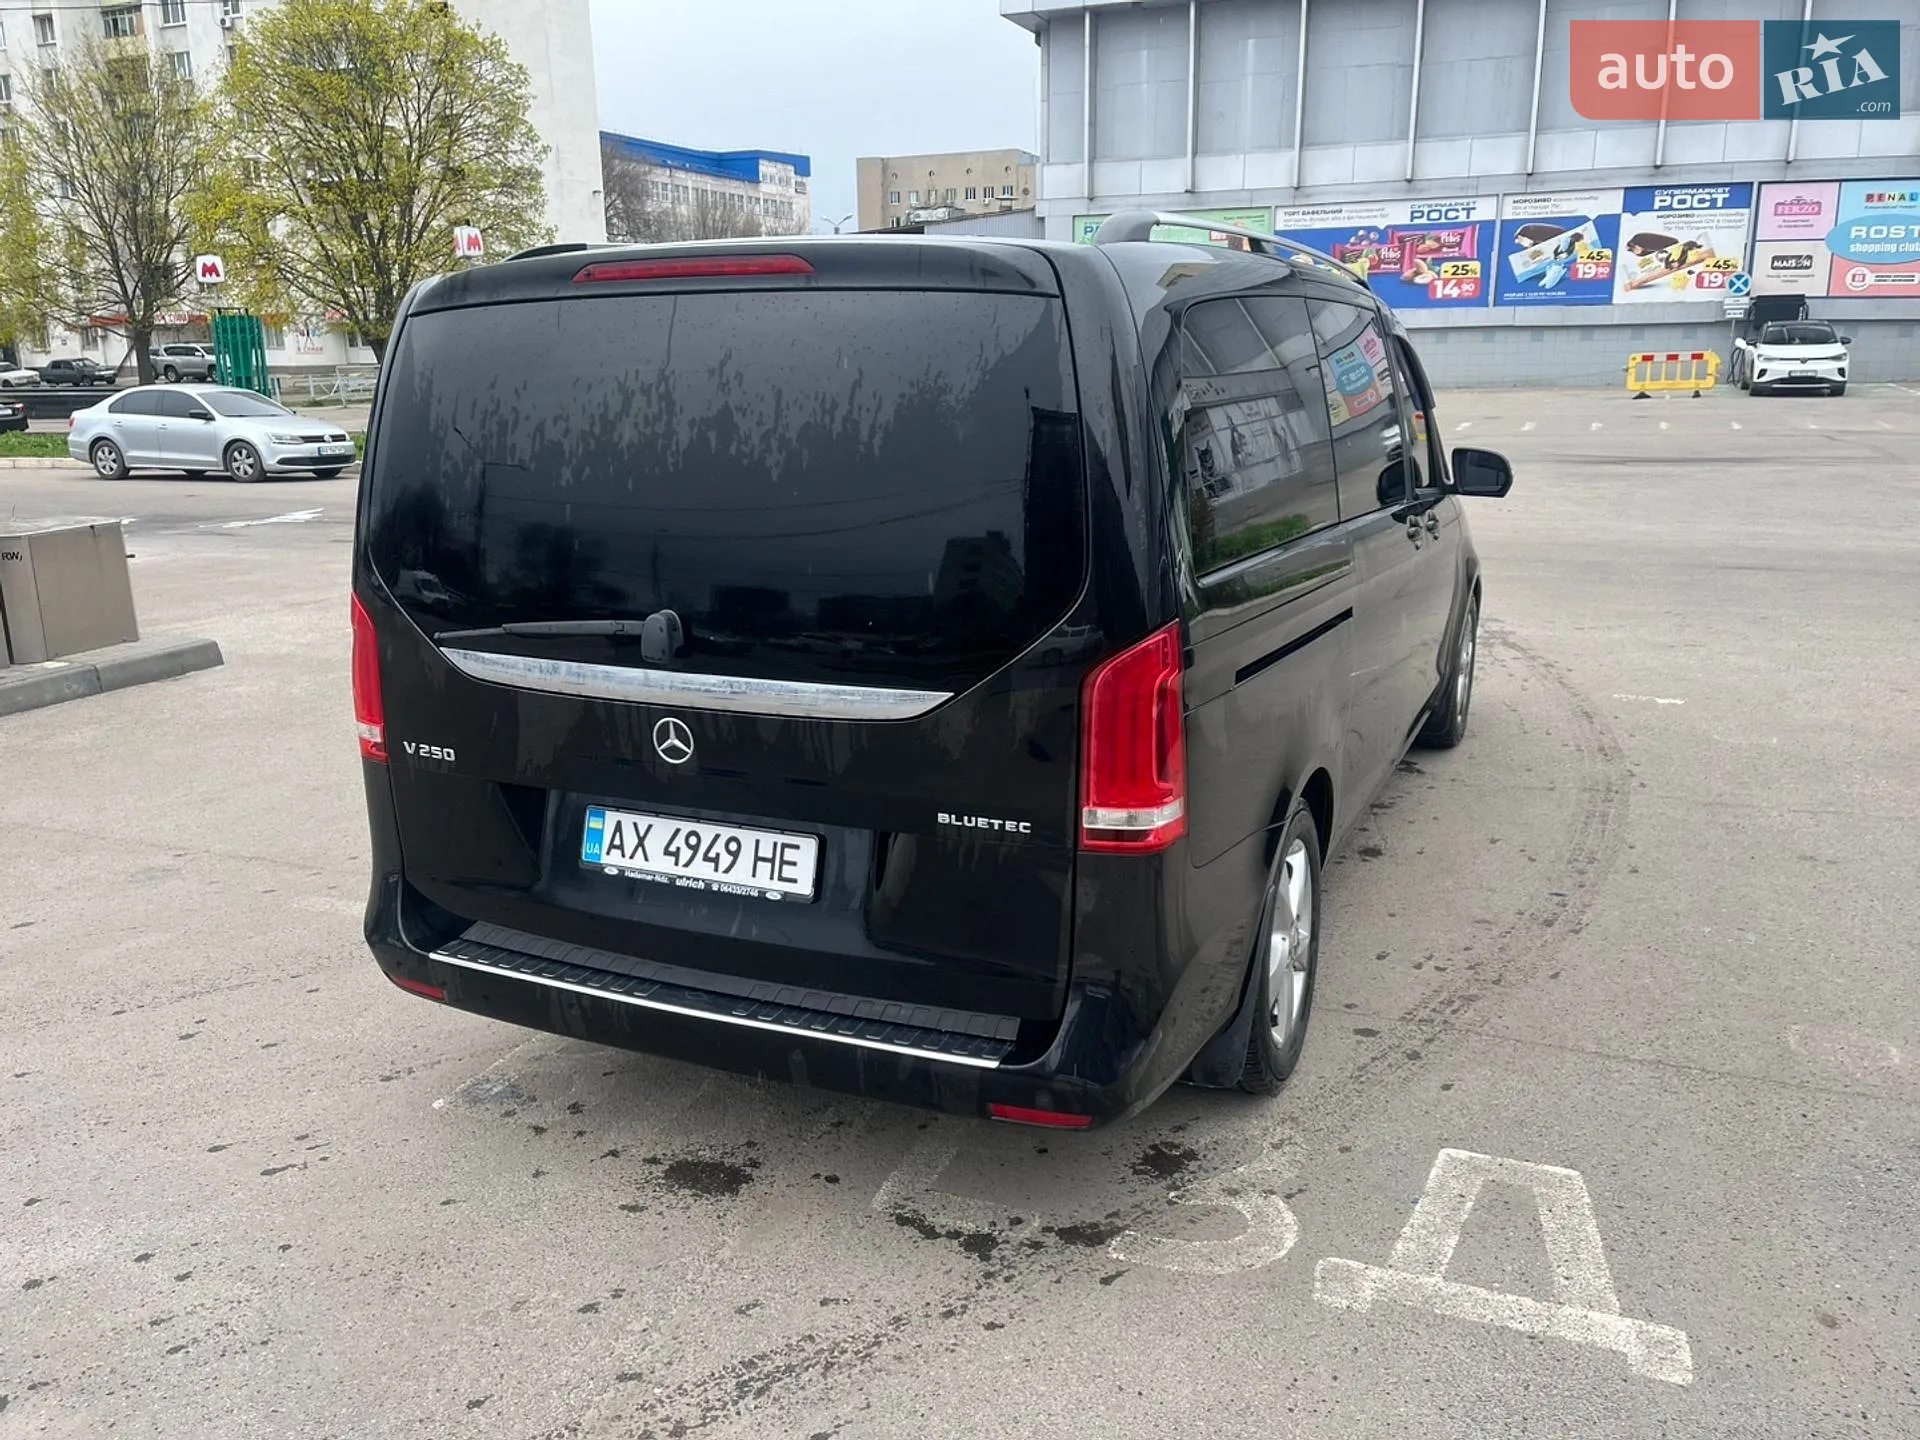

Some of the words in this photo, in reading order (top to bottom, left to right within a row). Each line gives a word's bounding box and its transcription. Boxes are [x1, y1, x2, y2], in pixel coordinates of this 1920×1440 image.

[1654, 187, 1730, 196] СУПЕРМАРКЕТ
[1410, 200, 1477, 209] СУПЕРМАРКЕТ
[1653, 193, 1730, 210] РОСТ
[1410, 207, 1477, 222] РОСТ
[1850, 225, 1920, 239] ROST
[1849, 242, 1898, 254] shopping
[402, 741, 416, 755] V
[418, 743, 456, 761] 250
[937, 812, 1031, 834] BLUETEC
[586, 842, 600, 856] UA
[605, 819, 653, 862] AX
[662, 827, 742, 875] 4949
[751, 838, 800, 884] HE
[675, 876, 705, 890] ulrich
